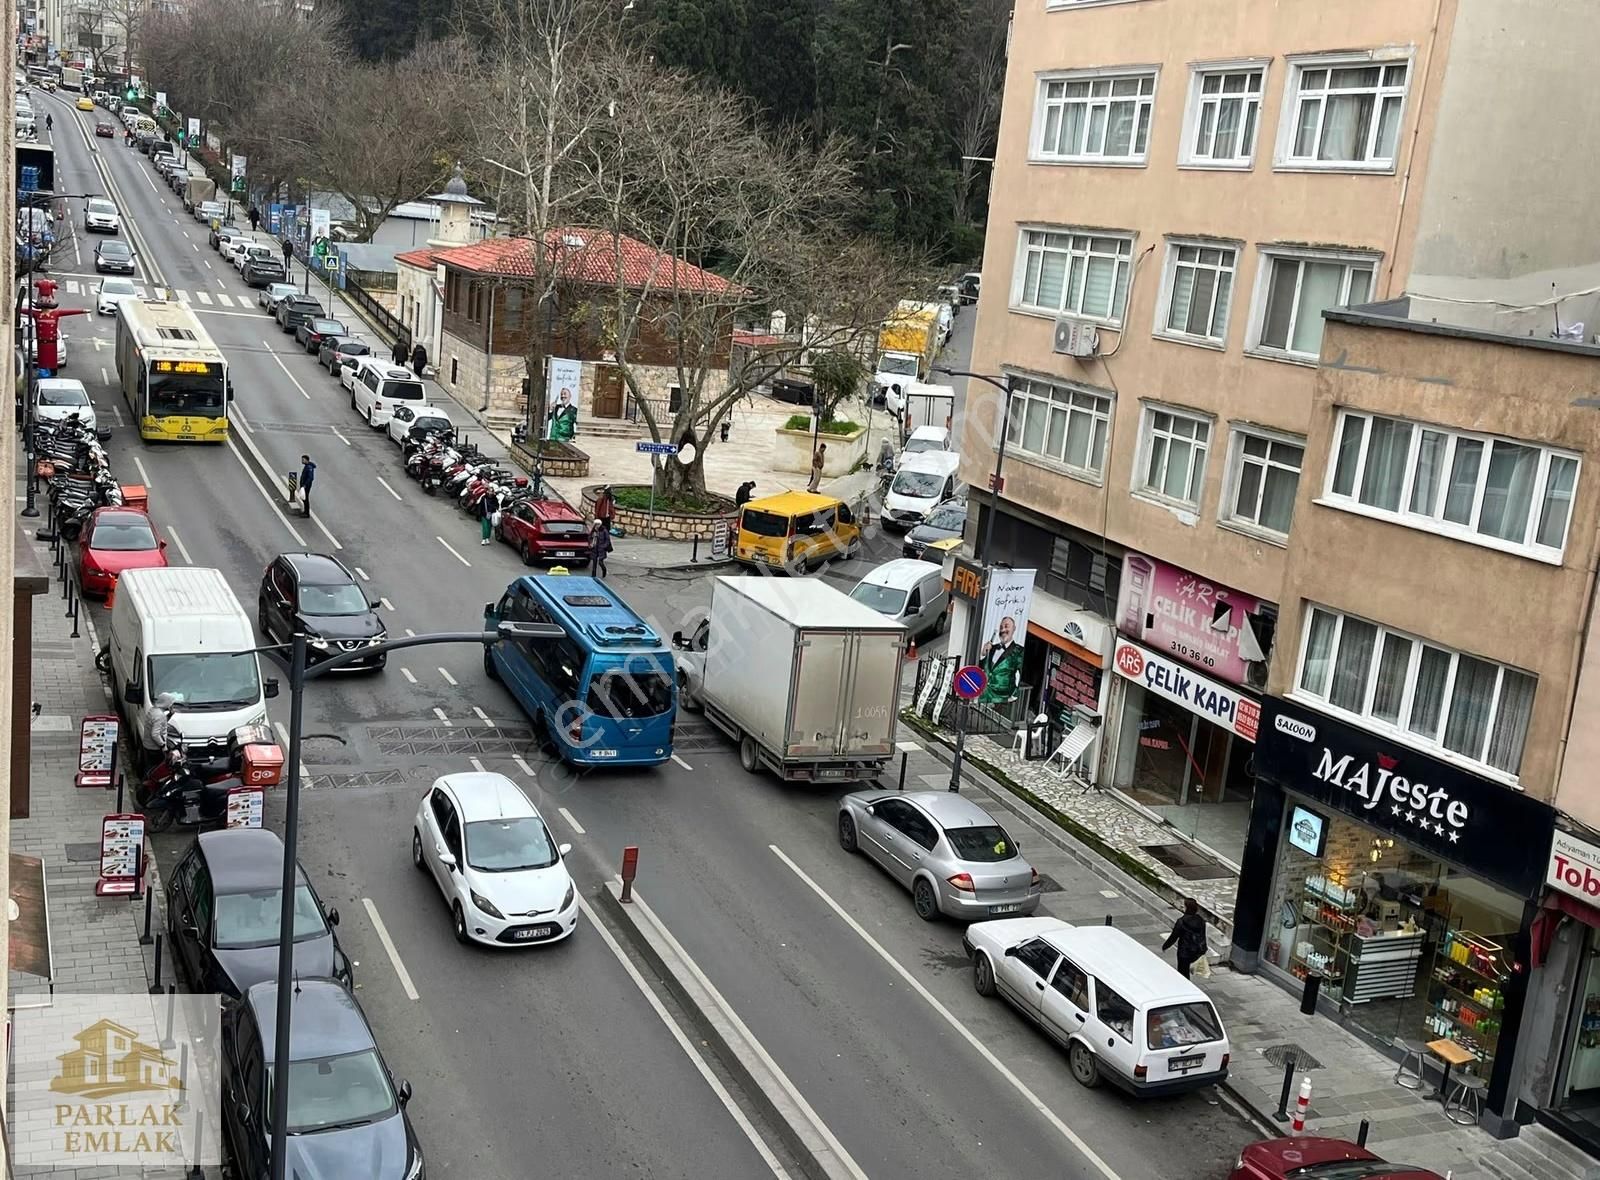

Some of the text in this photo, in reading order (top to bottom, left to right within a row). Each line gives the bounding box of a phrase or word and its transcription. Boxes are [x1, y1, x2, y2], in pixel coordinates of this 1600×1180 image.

[998, 584, 1025, 592] Naber
[1153, 595, 1196, 627] ÇELİK
[1119, 651, 1141, 674] ARS
[1171, 641, 1215, 667] 310 36 40
[1145, 660, 1191, 701] ÇELİK
[1193, 683, 1236, 723] KAPI
[1277, 719, 1313, 738] SALOON
[1554, 855, 1600, 896] Tob
